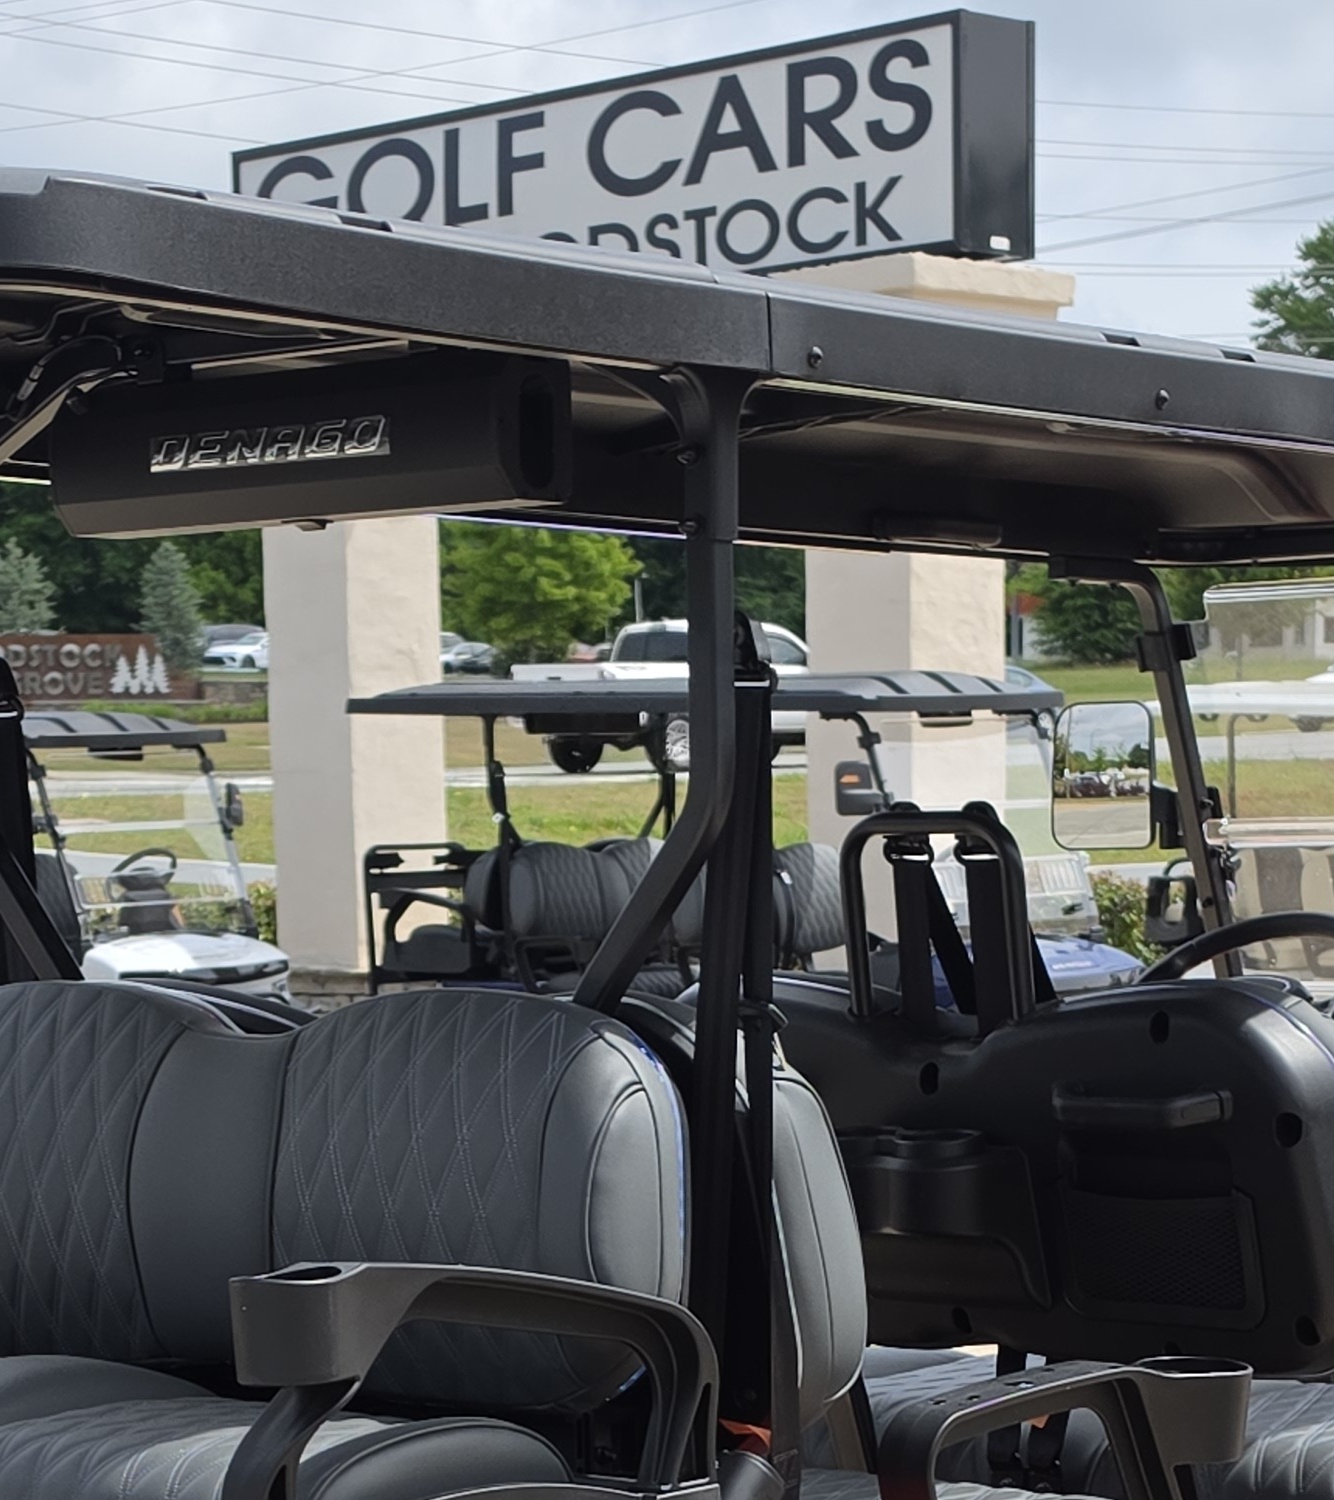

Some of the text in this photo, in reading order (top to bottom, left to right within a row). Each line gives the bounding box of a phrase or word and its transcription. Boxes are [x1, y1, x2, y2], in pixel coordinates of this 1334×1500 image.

[587, 38, 933, 197] CARS
[538, 174, 904, 266] STOCK
[150, 415, 387, 472] DENAGO
